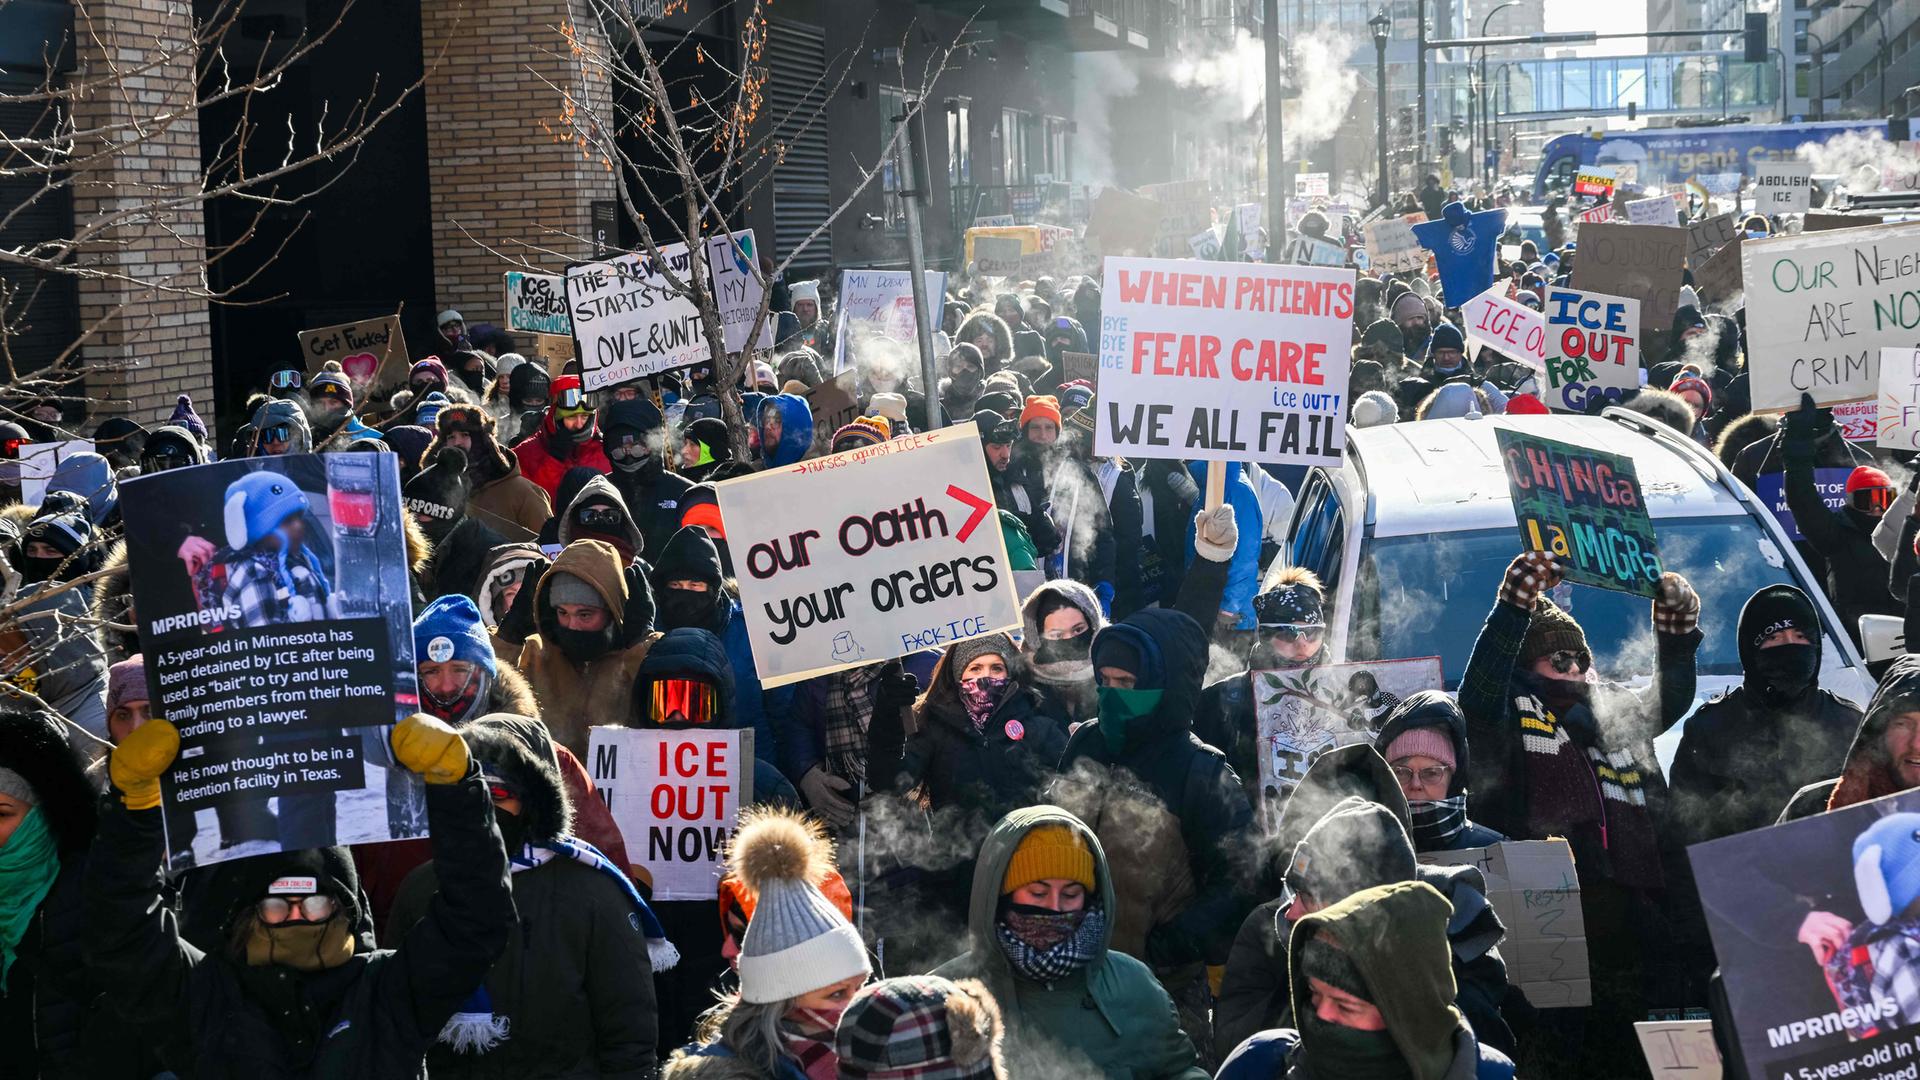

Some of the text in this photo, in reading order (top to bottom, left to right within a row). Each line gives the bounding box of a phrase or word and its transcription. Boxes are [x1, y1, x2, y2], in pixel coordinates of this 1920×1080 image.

[1648, 146, 1738, 173] Urgent
[1758, 175, 1809, 187] ABOLISH
[1773, 191, 1792, 202] ICE
[1690, 217, 1736, 254] ICE
[713, 242, 732, 274] I
[1772, 258, 1838, 293] OUR
[572, 267, 608, 298] THE
[723, 277, 746, 304] MY
[1118, 270, 1354, 320] WHEN PATIENTS
[575, 284, 654, 323] STARTS
[1548, 292, 1628, 333] ICE
[1804, 290, 1920, 342] ARE NO
[310, 323, 390, 356] Get Fucked
[1102, 334, 1126, 351] BYE
[1103, 316, 1128, 332] BYE
[1476, 300, 1545, 359] ICE OU
[1101, 355, 1124, 370] ICE
[1131, 332, 1327, 386] FEAR CARE
[1561, 327, 1634, 366] OUT
[1544, 356, 1597, 388] FOR
[1274, 386, 1340, 416] ice OUT!
[1108, 402, 1343, 458] WE ALL FAIL
[808, 436, 924, 474] nurses against ICE
[410, 498, 455, 520] SPORTS
[746, 529, 820, 580] our
[764, 555, 998, 646] your orders
[152, 603, 242, 636] MPRnews
[946, 616, 990, 641] ICE
[1753, 619, 1794, 646] CLOAK
[158, 629, 354, 668] A 5-year-old in Minnesota has
[160, 646, 375, 686] been detained by ICE after being
[162, 687, 190, 704] used
[192, 685, 206, 698] as
[250, 674, 265, 688] to
[268, 672, 289, 689] try
[292, 668, 319, 683] and
[322, 666, 349, 680] lure
[164, 682, 386, 723] family members from their home,
[228, 716, 243, 729] to
[246, 716, 256, 726] a
[258, 708, 308, 726] lawyer.
[174, 747, 354, 784] He is now thought to be in a
[659, 742, 728, 778] ICE
[176, 766, 342, 803] detention facility in Texas.
[650, 784, 730, 820] OUT
[1522, 872, 1576, 909] Resist
[1767, 996, 1899, 1048] MPRnews
[1799, 1045, 1892, 1080] 5-year-old
[1894, 1041, 1913, 1059] in
